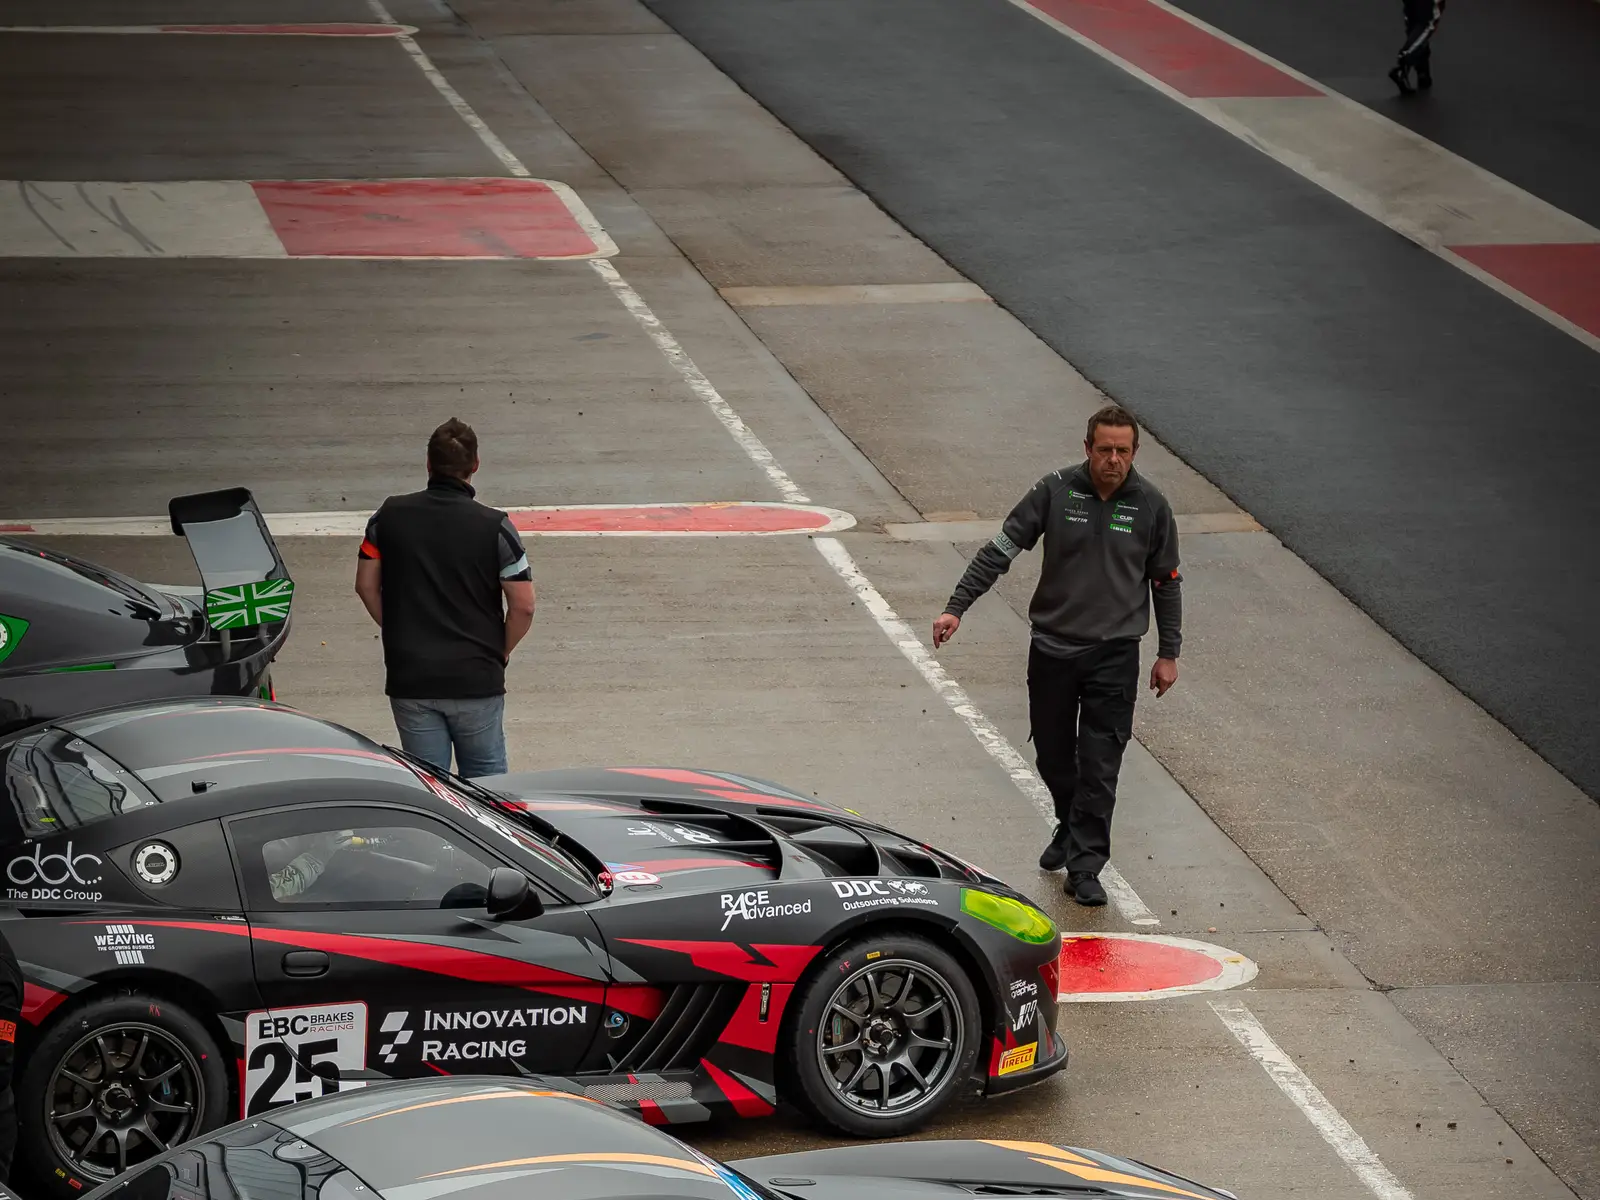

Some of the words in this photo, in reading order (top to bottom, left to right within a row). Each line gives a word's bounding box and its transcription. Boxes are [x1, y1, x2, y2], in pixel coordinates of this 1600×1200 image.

[7, 888, 28, 899] The
[31, 889, 61, 900] DDC
[63, 889, 103, 902] Group
[721, 890, 770, 909] RACE
[831, 880, 891, 899] DDC
[721, 896, 812, 931] Advanced
[843, 896, 899, 911] Outsourcing
[900, 896, 939, 906] Solutions
[94, 934, 155, 945] WEAVING
[258, 1014, 310, 1039] EBC
[310, 1011, 354, 1024] BRAKES
[310, 1022, 354, 1033] RACING
[424, 1006, 587, 1031] INNOVATION
[422, 1039, 527, 1061] RACING
[1002, 1047, 1033, 1069] PIRELLI
[246, 1038, 341, 1119] 25
